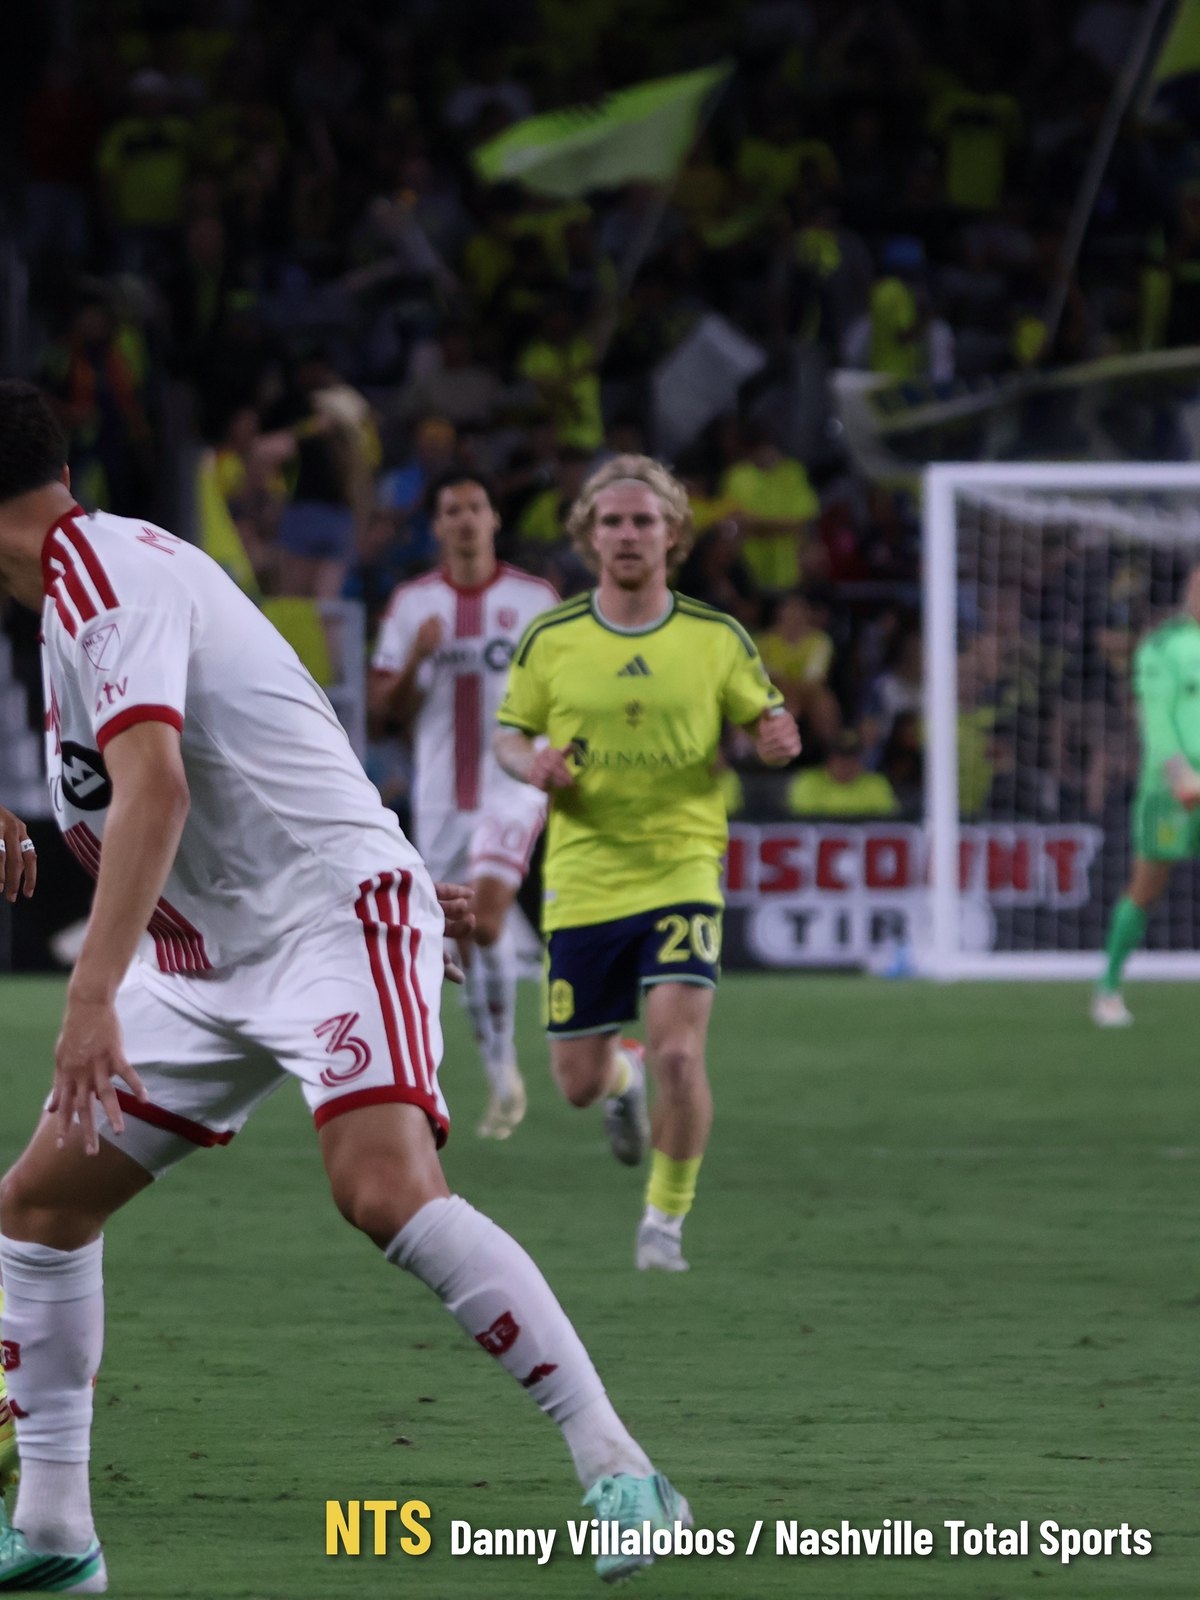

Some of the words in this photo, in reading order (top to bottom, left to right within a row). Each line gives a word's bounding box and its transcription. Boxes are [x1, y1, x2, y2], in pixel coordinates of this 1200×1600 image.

[726, 836, 1080, 893] ISCONT
[655, 913, 721, 964] 20
[783, 906, 912, 946] TIR
[313, 1011, 373, 1088] 3
